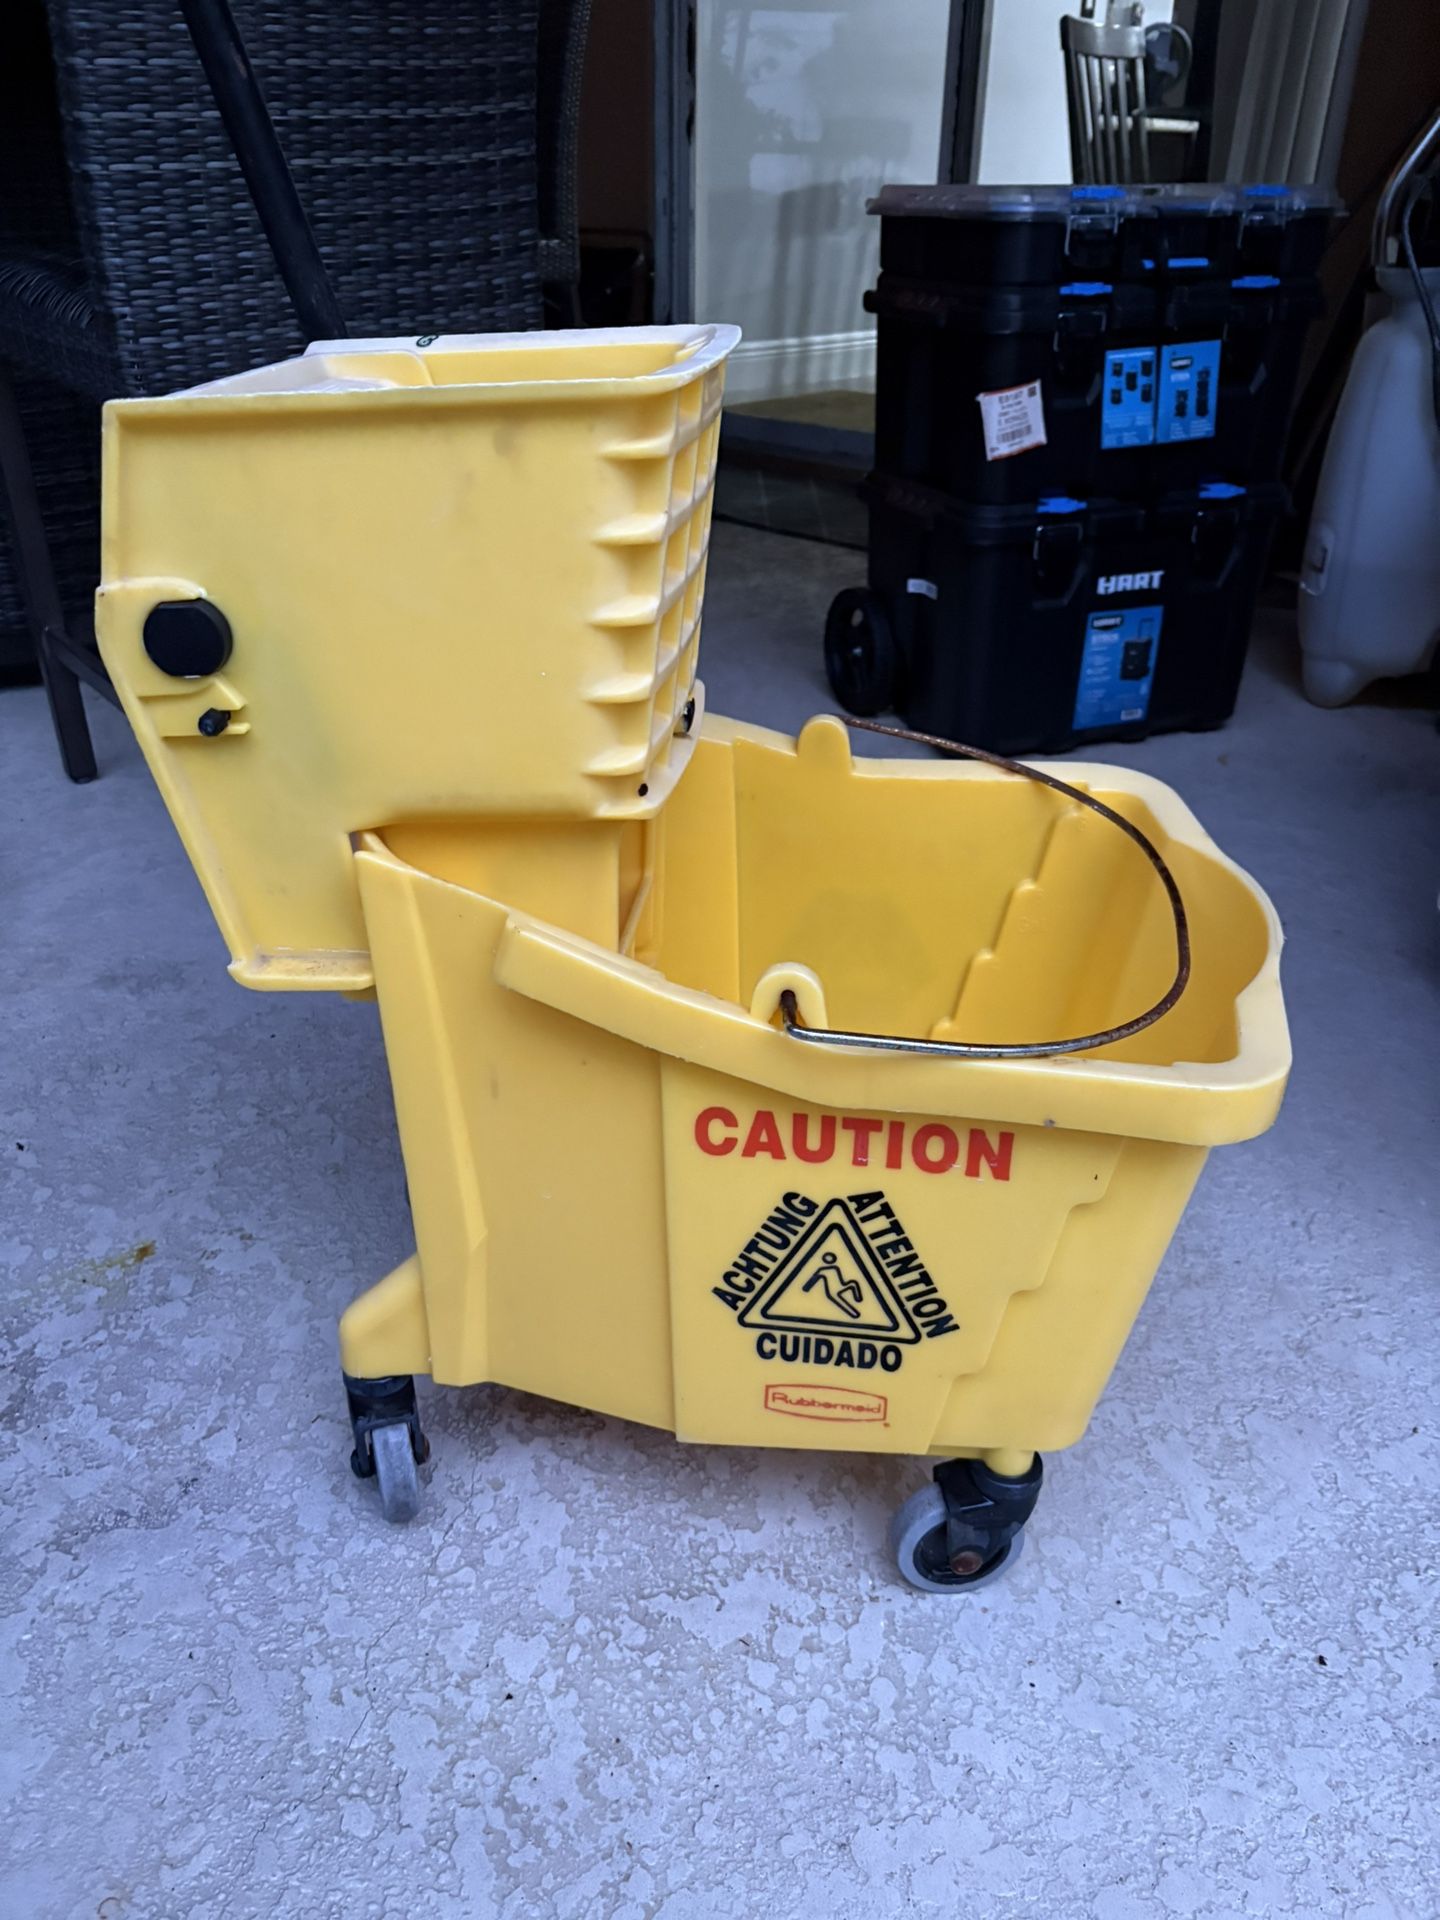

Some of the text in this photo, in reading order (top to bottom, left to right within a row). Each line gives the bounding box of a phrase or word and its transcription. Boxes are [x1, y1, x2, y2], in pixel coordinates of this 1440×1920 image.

[1096, 570, 1164, 595] HART
[694, 1106, 1015, 1181] CAUTION
[711, 1191, 819, 1311] ACHTUNG
[847, 1190, 960, 1338] ATTENTION
[756, 1332, 903, 1372] CUIDADO
[772, 1392, 881, 1413] Rubbermaid
